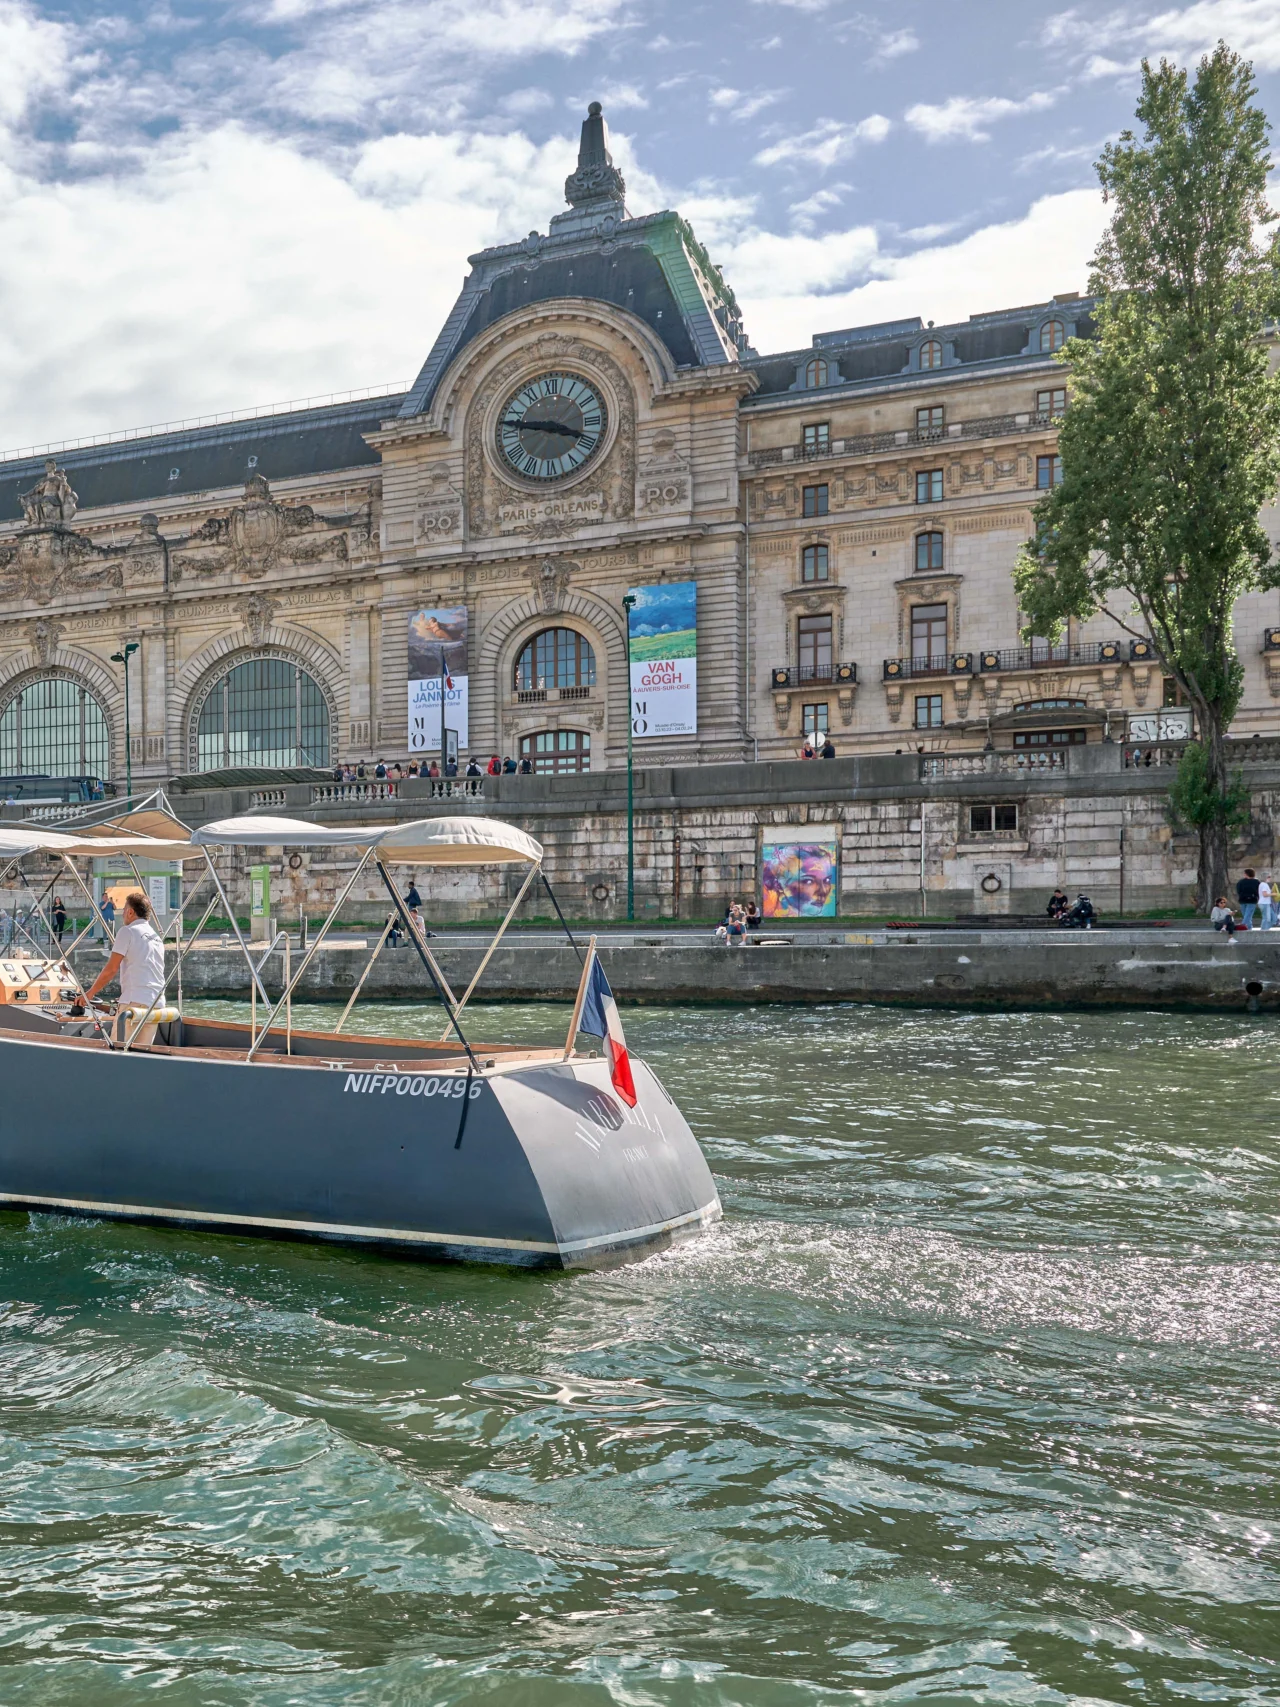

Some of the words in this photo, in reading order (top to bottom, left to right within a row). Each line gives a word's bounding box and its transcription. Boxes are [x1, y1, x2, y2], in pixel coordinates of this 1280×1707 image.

[544, 379, 559, 396] XII
[567, 381, 577, 397] I
[523, 387, 538, 405] XI
[579, 394, 595, 409] II
[507, 406, 524, 418] X
[584, 415, 601, 427] III
[507, 443, 525, 465] VIII
[567, 453, 579, 468] V
[523, 456, 538, 475] VII
[546, 460, 557, 476] VI
[646, 485, 679, 504] PO
[502, 500, 599, 522] PARIS-ORLEANS
[423, 516, 452, 533] PO
[478, 568, 519, 582] BLOIS
[579, 553, 627, 569] TOURS
[177, 604, 229, 616] QUIMPER
[283, 591, 342, 607] AURILLAC
[70, 616, 116, 630] LORIENT
[648, 661, 675, 673] VAN
[641, 672, 682, 686] GOGH
[413, 689, 463, 703] JANMOT
[638, 684, 691, 693] AUVERS-SUR-OISE
[635, 701, 647, 715] M
[414, 717, 424, 730] M
[343, 1073, 484, 1099] NIFP000496
